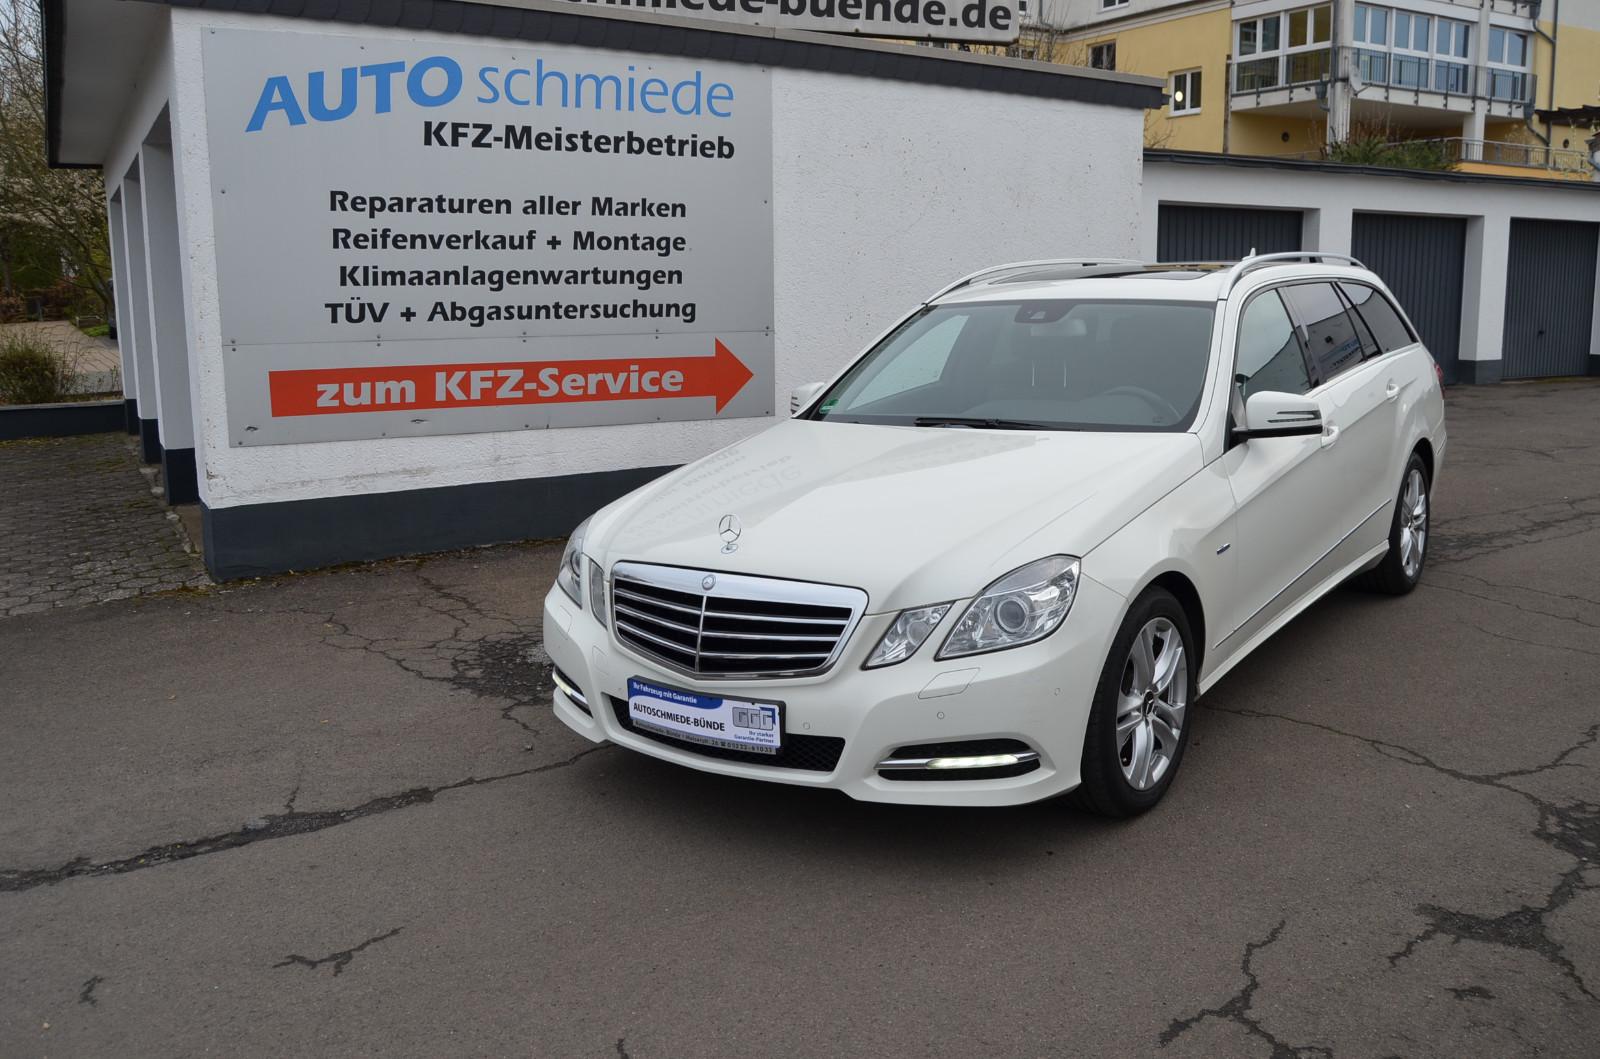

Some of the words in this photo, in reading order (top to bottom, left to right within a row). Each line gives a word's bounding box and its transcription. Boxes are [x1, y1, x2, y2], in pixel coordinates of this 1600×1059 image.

[244, 55, 463, 133] AUTO
[477, 58, 735, 118] schmiede
[424, 121, 735, 159] KFZ-Meisterbetrieb
[330, 191, 512, 218] Reparaturen
[522, 196, 581, 216] aller
[592, 197, 687, 217] Marken
[333, 228, 537, 251] Reifenverkauf
[547, 236, 562, 250] +
[573, 231, 687, 258] Montage
[340, 265, 683, 292] Klimaanlagenwartungen
[325, 298, 390, 323] TÜV
[401, 307, 416, 322] +
[428, 299, 696, 328] Abgasuntersuchung
[316, 380, 416, 407] zum
[435, 364, 684, 402] KFZ-Service
[640, 683, 663, 698] Fahrzeug
[663, 690, 673, 698] mit
[672, 692, 698, 704] Garantie
[633, 702, 725, 731] AUTOSCHMIEDE-BÜNDE
